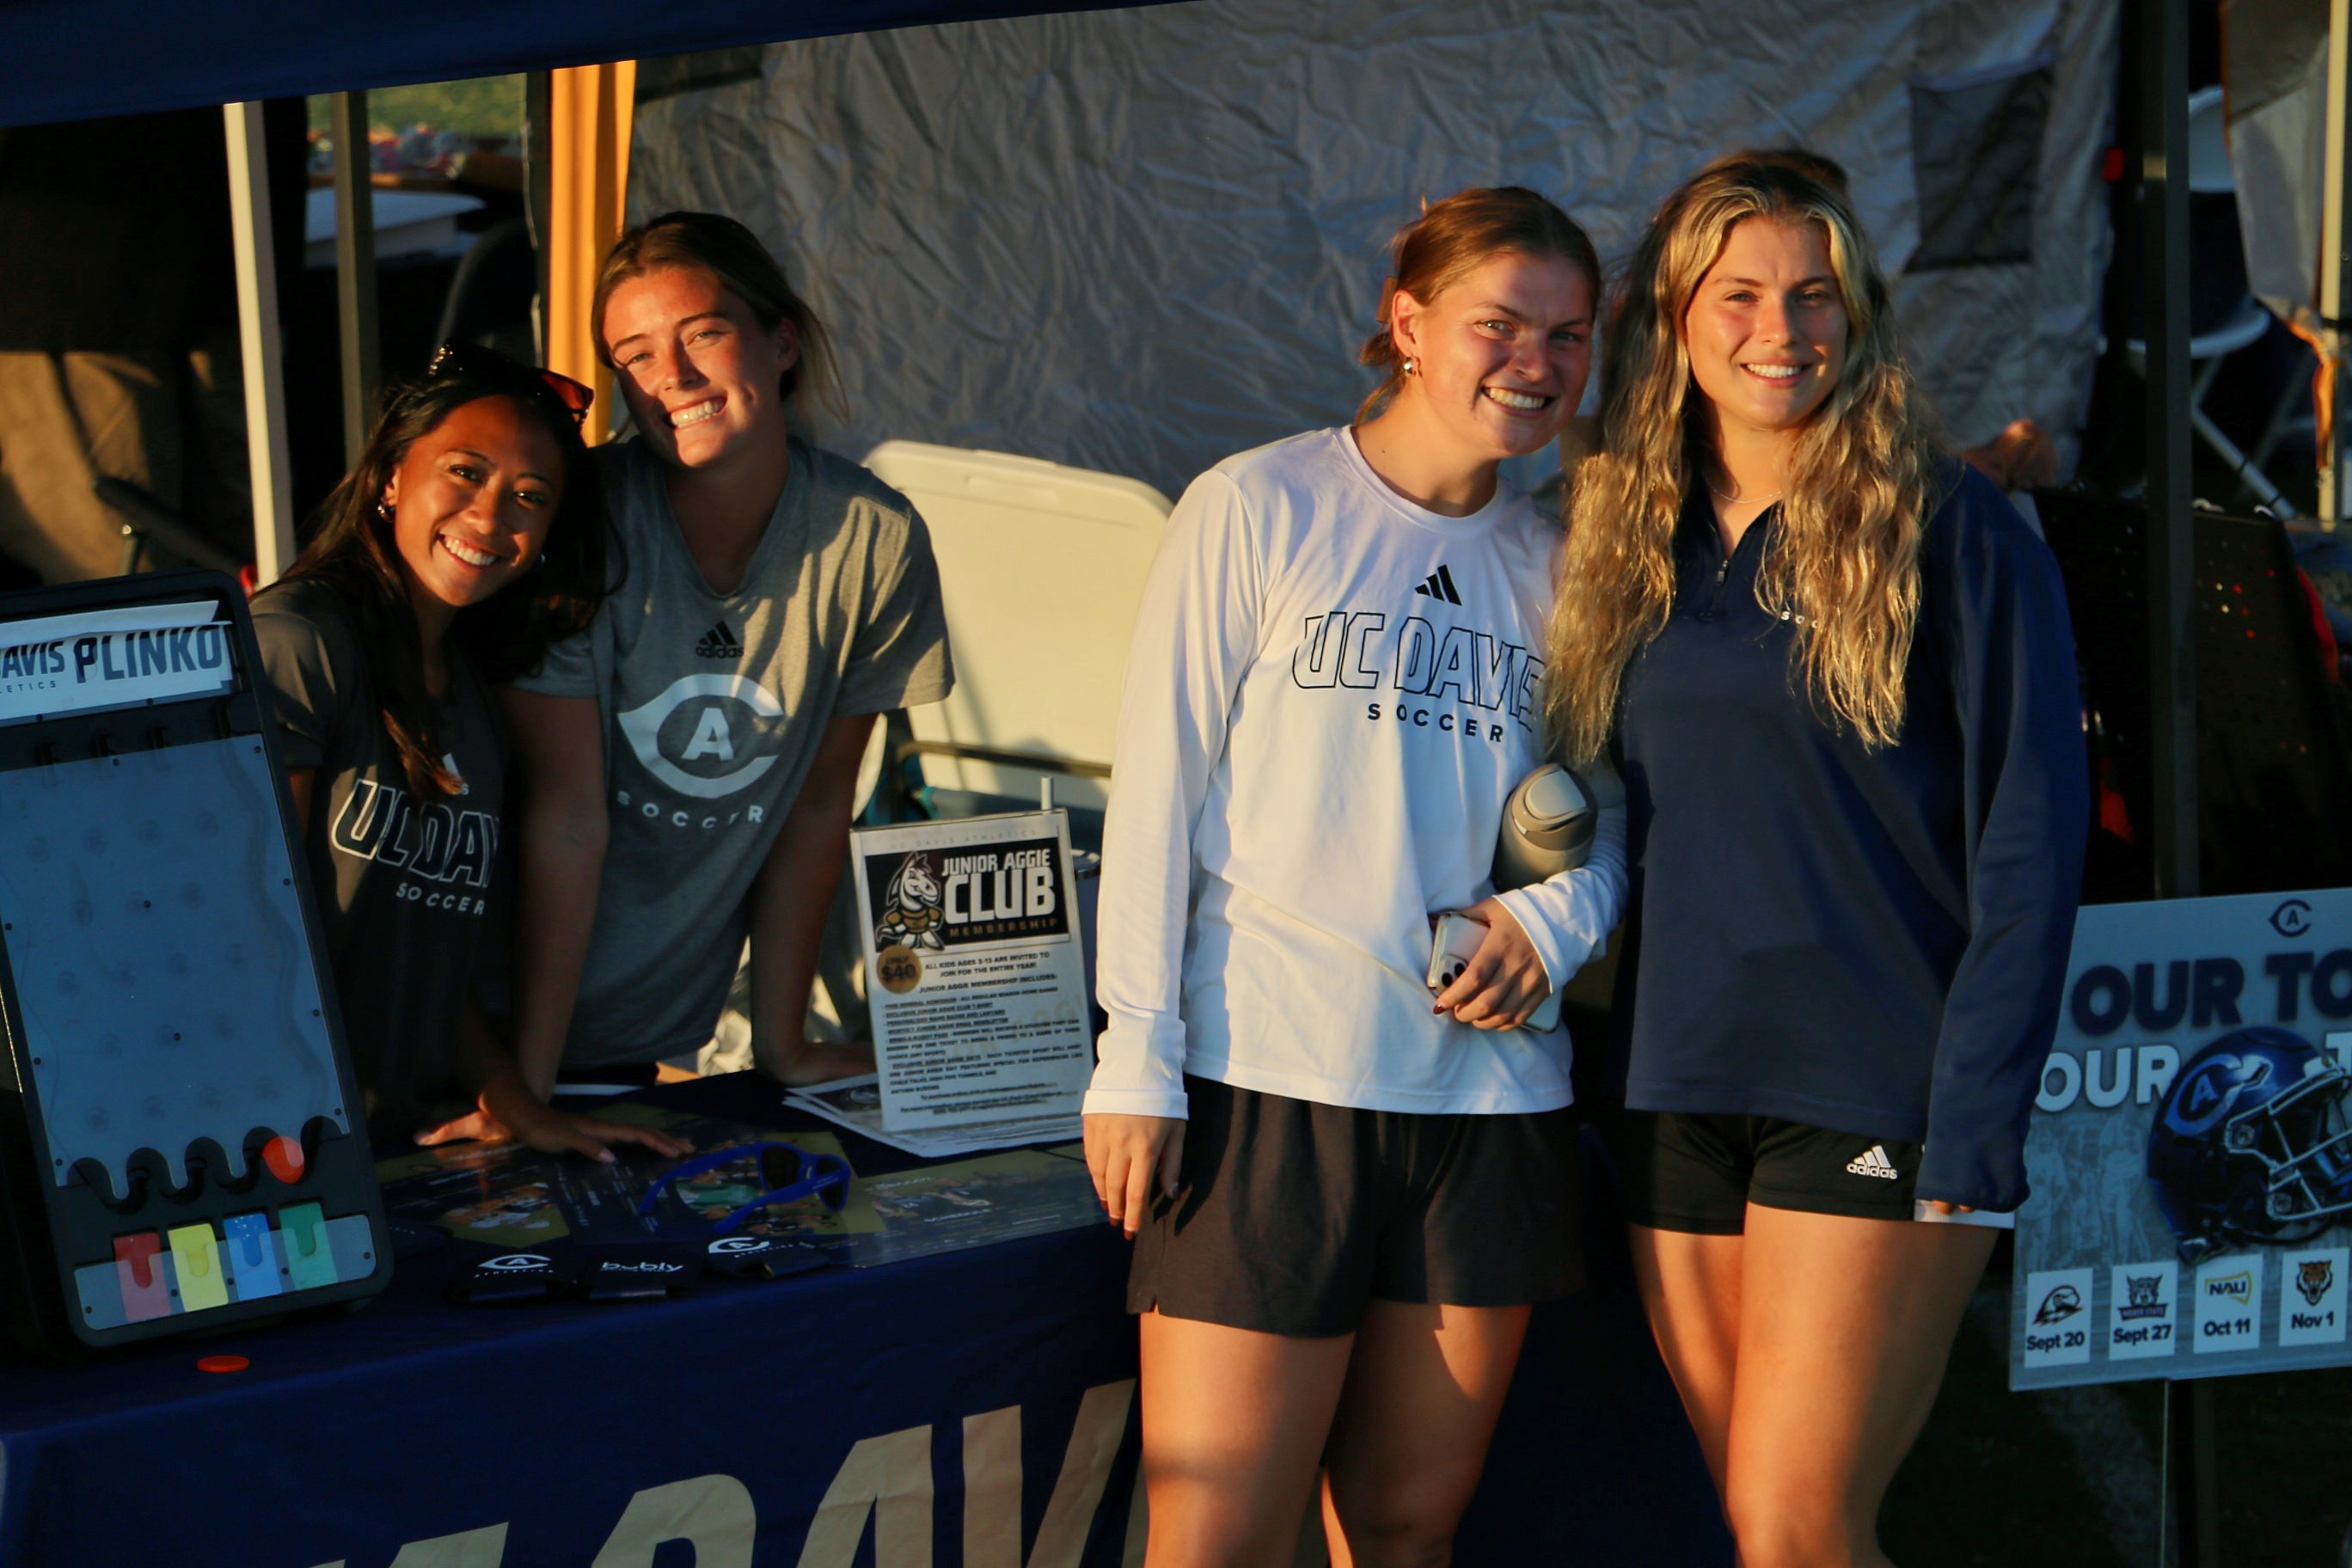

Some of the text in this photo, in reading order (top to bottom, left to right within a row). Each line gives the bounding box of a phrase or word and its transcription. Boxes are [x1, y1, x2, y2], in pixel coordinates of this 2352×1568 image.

[74, 625, 223, 683] PLINKO
[695, 645, 744, 658] adidas
[1292, 612, 1385, 689] UC
[0, 681, 56, 693] ETICS
[1368, 703, 1504, 742] SOCCER
[616, 790, 763, 829] SOCCR
[408, 801, 499, 888] DA
[942, 848, 1050, 877] JUNIOR AGGIE
[395, 882, 487, 915] SOCCER
[946, 867, 1056, 924] CLUB
[949, 918, 1057, 937] MEMBERSHIP
[1009, 952, 1038, 961] INVITED
[881, 963, 916, 983] $40
[970, 977, 1018, 988] MEMBERSHIP
[2072, 958, 2244, 1036] OUR
[2035, 1044, 2180, 1112] OUR
[1846, 1162, 1898, 1180] adidas
[2209, 1279, 2247, 1295] NAU
[2204, 1318, 2251, 1337] Oct 11
[2292, 1311, 2335, 1330] Nov 1
[2027, 1332, 2085, 1353] Sept 20
[2114, 1325, 2171, 1345] Sept 27
